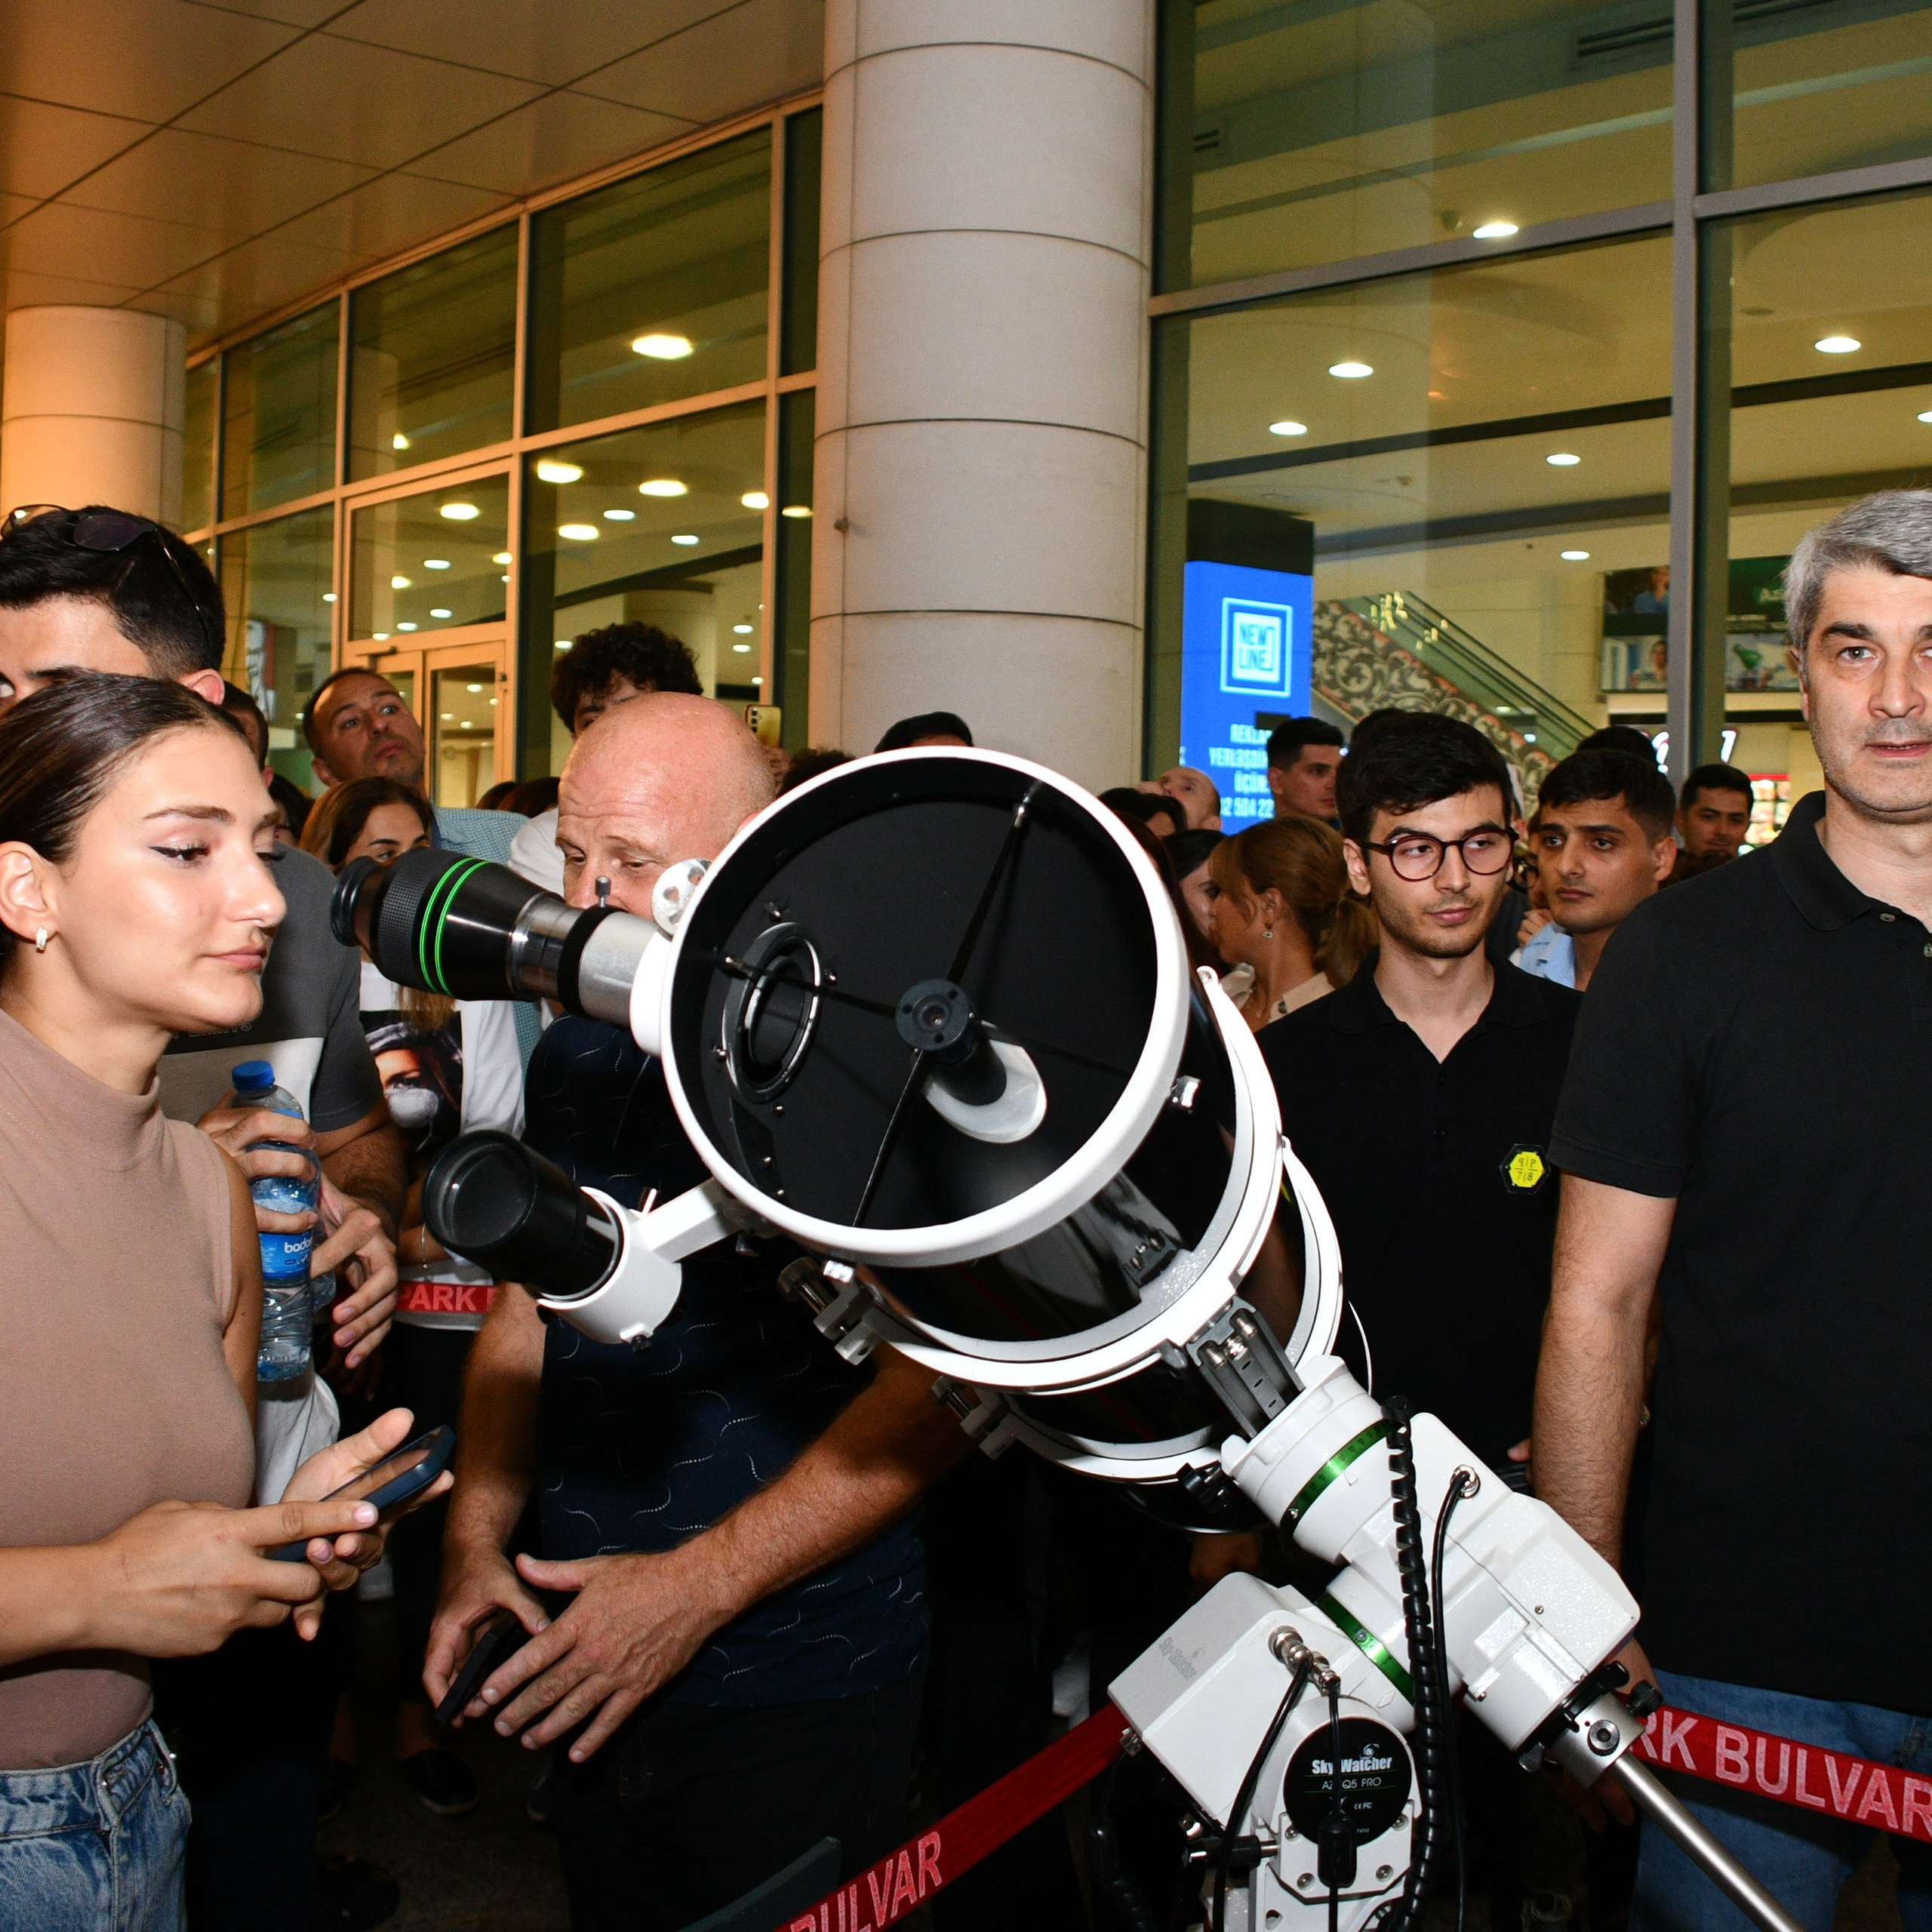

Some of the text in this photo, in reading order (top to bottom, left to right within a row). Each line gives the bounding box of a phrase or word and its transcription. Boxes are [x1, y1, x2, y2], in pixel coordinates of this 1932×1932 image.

[1312, 1756, 1393, 1775] SkyWatcher
[1361, 1777, 1382, 1788] PRO
[1715, 1724, 1932, 1838] BULVAR
